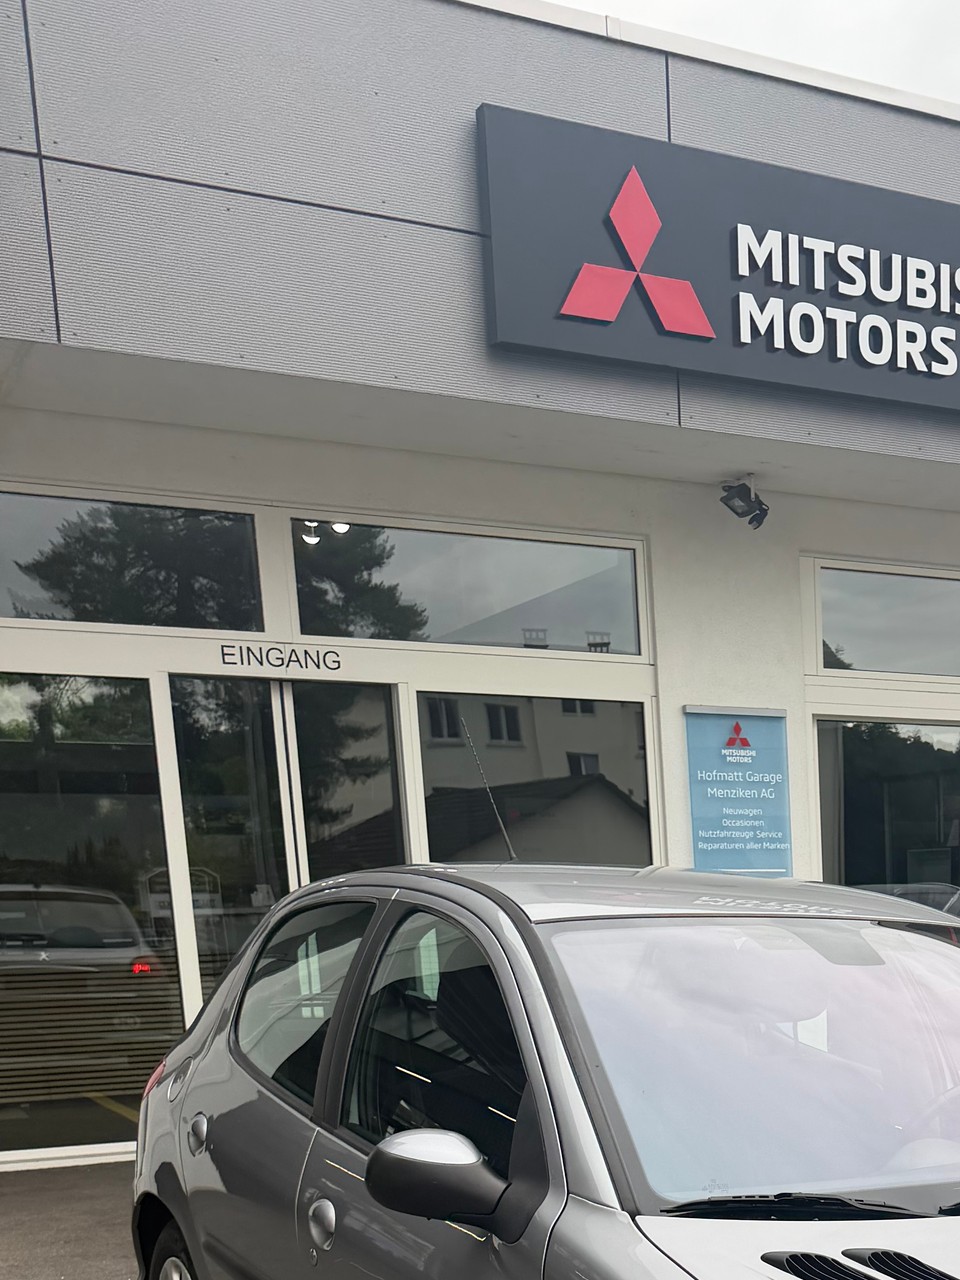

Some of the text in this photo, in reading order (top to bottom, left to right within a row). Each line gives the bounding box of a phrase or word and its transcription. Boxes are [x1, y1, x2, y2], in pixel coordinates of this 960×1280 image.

[739, 290, 959, 377] MOTORS
[220, 644, 341, 671] EINGANG
[722, 749, 756, 757] MITSUBISHI
[697, 770, 783, 784] Hofmatt Garage
[707, 788, 775, 799] Menziken AG
[723, 807, 763, 817] Neuwagen
[722, 819, 765, 828] Occasionen
[699, 830, 783, 840] Nutzfahrzeuge Service
[698, 841, 790, 851] Reparaturen aller Marken
